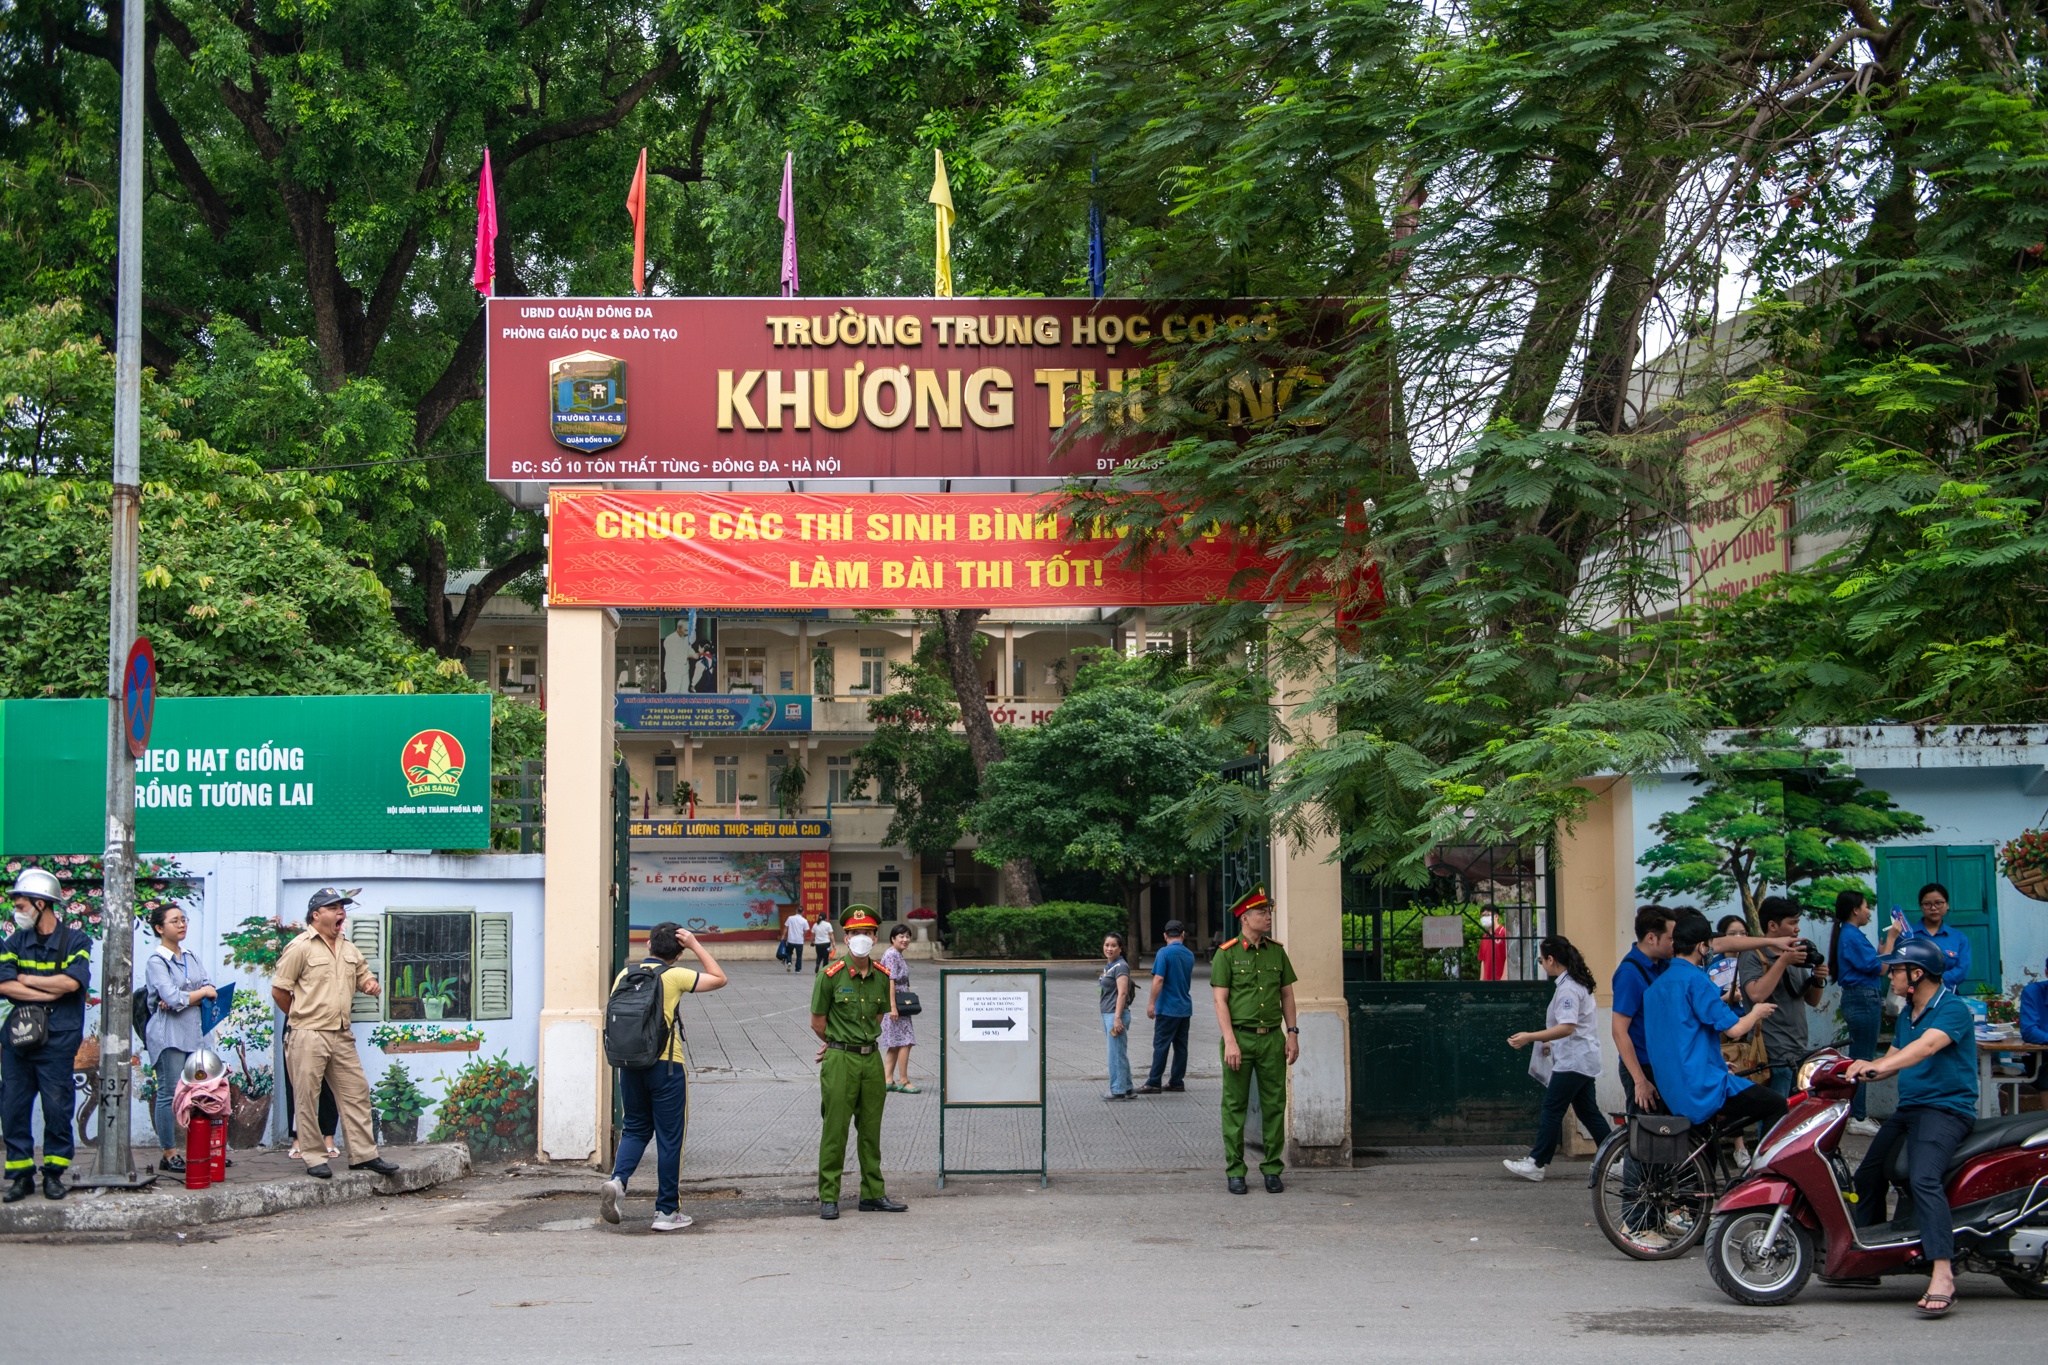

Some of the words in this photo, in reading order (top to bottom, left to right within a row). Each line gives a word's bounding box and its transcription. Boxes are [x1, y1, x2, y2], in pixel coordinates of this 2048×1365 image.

[520, 307, 555, 318] UBND
[558, 304, 594, 321] QUẬN
[635, 307, 653, 318] ĐA
[502, 325, 545, 339] PHÒNG
[548, 325, 578, 339] GIÁO
[581, 328, 608, 342] DỤC
[610, 328, 620, 339] &
[623, 325, 650, 339] ĐÀO
[652, 328, 678, 342] TẠO
[766, 306, 922, 346] TRƯỜNG
[931, 314, 1061, 346] TRUNG
[1071, 313, 1151, 355] HỌC
[716, 360, 1015, 429] KHƯƠNG
[557, 413, 590, 422] TRƯỜNG
[566, 436, 584, 444] QUẬN
[511, 460, 538, 473] ĐC:
[541, 455, 562, 473] SỐ
[566, 461, 582, 473] 10
[585, 457, 616, 473] TÔN
[619, 455, 657, 473] THẤT
[660, 457, 700, 473] TÙNG
[758, 460, 780, 473] ĐA
[792, 456, 812, 472] HÀ
[816, 456, 841, 475] NỘI
[1096, 458, 1120, 470] ĐT:
[595, 506, 696, 540] CHÚC
[709, 507, 784, 540] CÁC
[795, 507, 854, 541] THÍ
[866, 513, 956, 541] SINH
[969, 507, 1058, 541] BÌNH
[1701, 539, 1728, 573] XÂY
[1733, 525, 1775, 565] DỰNG
[789, 556, 869, 588] LÀM
[882, 556, 944, 588] BÀI
[955, 560, 1013, 588] THI
[1025, 550, 1103, 588] TỐT!
[187, 748, 229, 776] HẠT
[235, 739, 304, 771] GIỐNG
[199, 781, 273, 807] TƯƠNG
[279, 783, 314, 806] LAI
[387, 805, 398, 815] HỘI
[416, 805, 427, 815] ĐỘI
[428, 805, 449, 814] THÀNH
[450, 803, 462, 813] PHỐ
[462, 804, 471, 813] HÀ
[472, 804, 484, 815] NỘI
[686, 823, 721, 838] LƯỢNG
[778, 821, 798, 836] QUẢ
[801, 824, 821, 835] CAO
[646, 872, 663, 883] LỄ
[668, 871, 707, 883] TỔNG
[712, 871, 742, 883] KẾT
[12, 1034, 33, 1044] adidas
[100, 1094, 124, 1107] KT
[106, 1116, 115, 1128] 7
